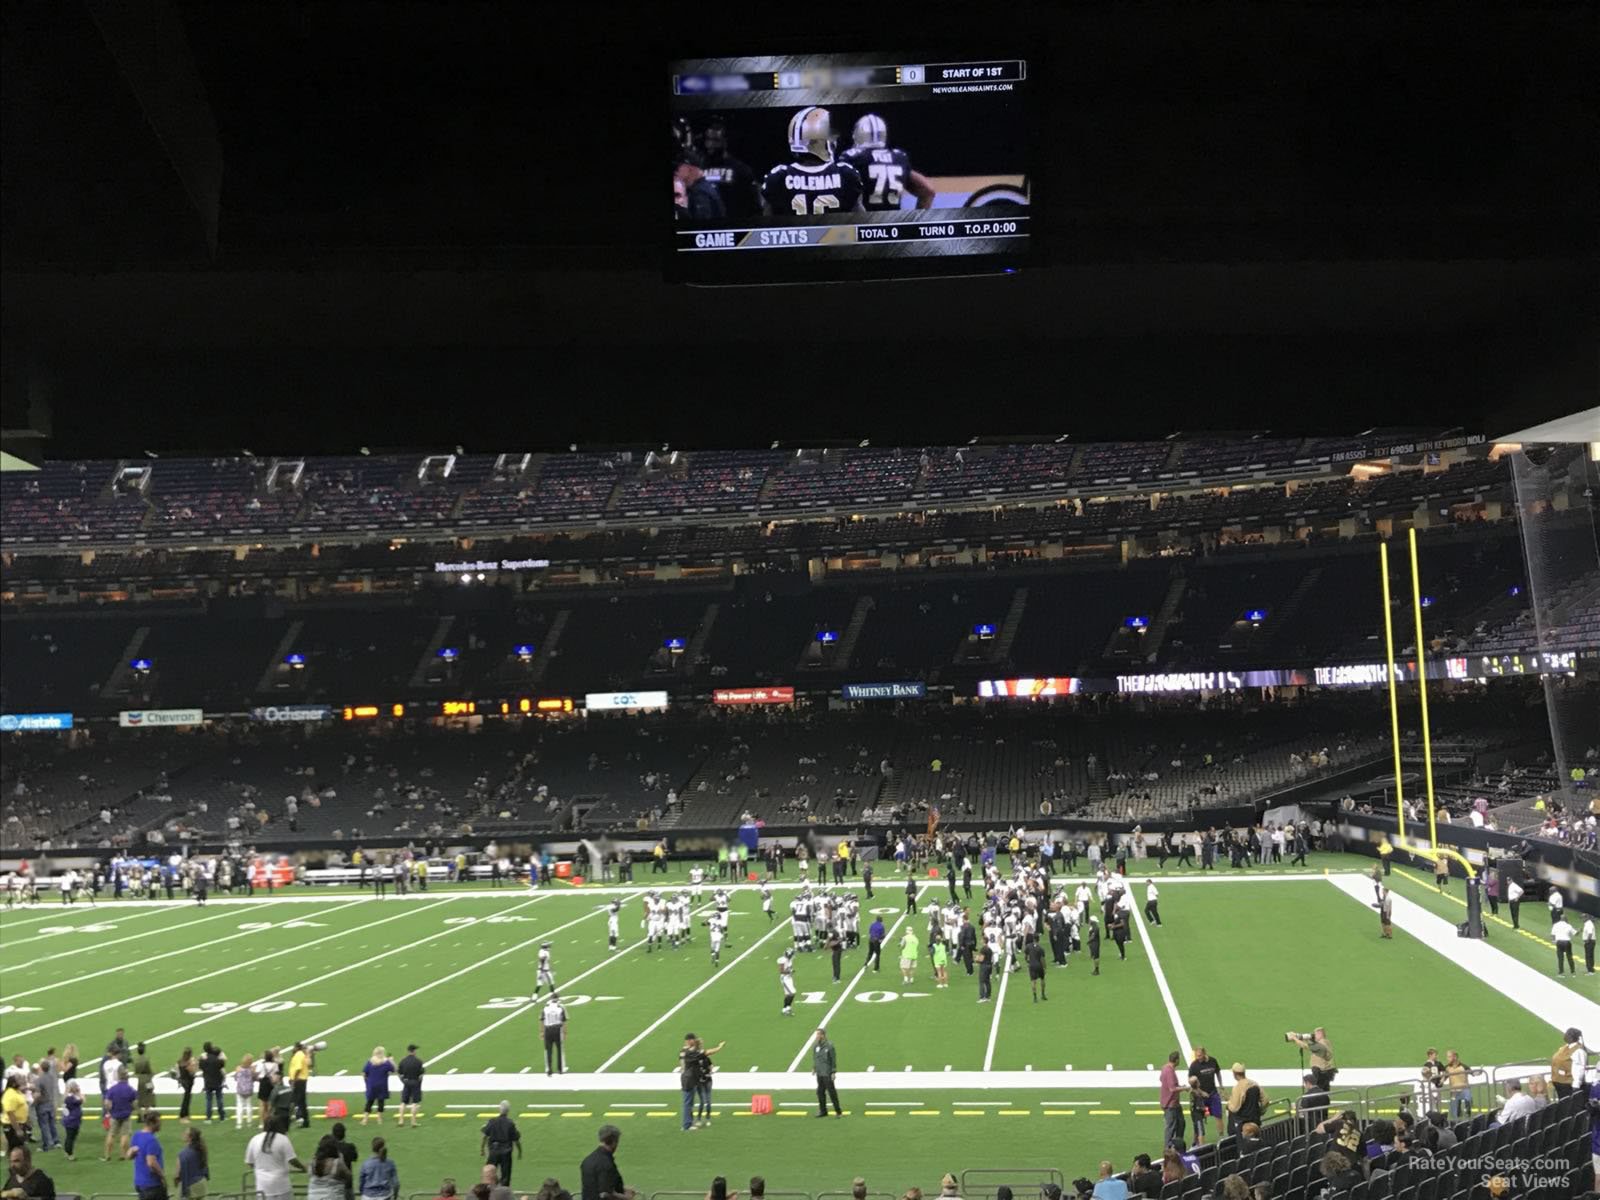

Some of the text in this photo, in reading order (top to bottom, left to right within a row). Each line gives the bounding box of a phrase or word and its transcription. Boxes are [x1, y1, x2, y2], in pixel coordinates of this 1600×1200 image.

[909, 70, 917, 80] 0
[942, 67, 1003, 79] START OF 1ST
[785, 174, 841, 190] COLEMAN
[868, 164, 905, 204] 75
[860, 228, 899, 239] TOTAL 0
[919, 225, 955, 236] TURN 0
[695, 230, 808, 248] GAME STATS
[848, 684, 920, 697] WHITNEY BANK
[147, 712, 196, 723] Chevron
[265, 706, 326, 721] Ochsner
[795, 990, 899, 1003] 10
